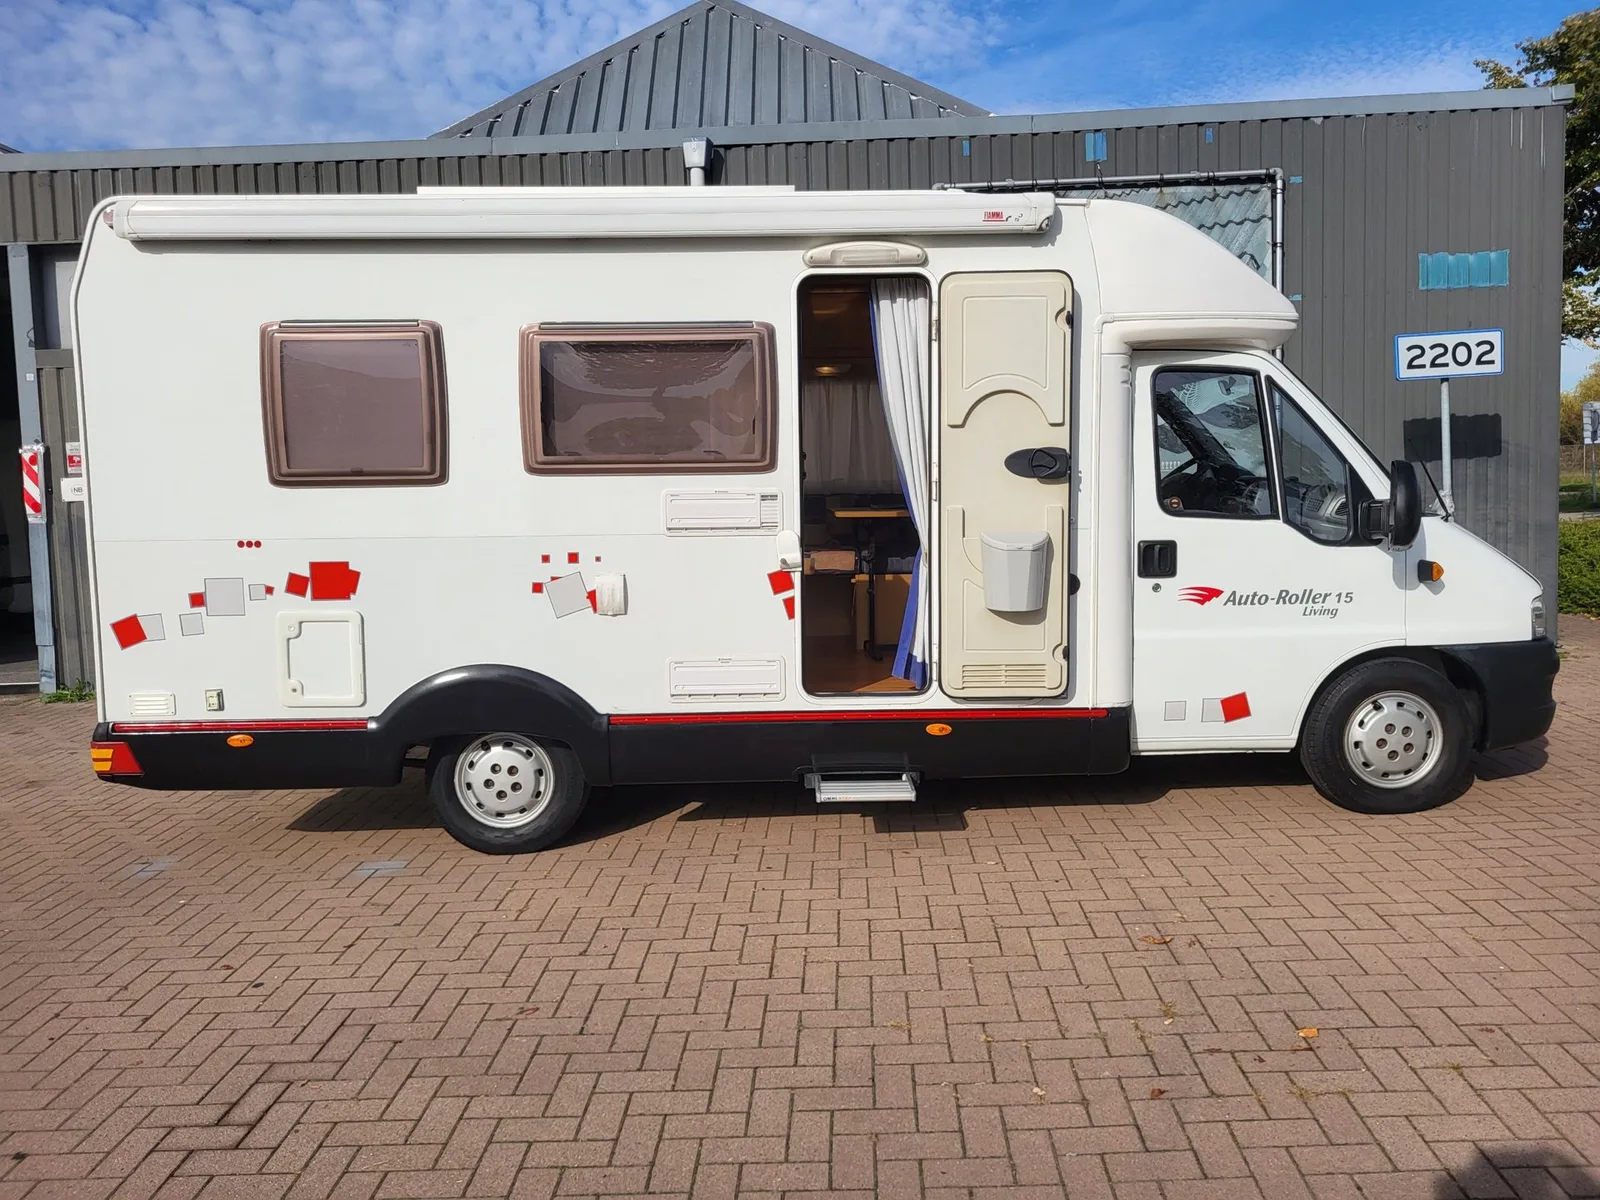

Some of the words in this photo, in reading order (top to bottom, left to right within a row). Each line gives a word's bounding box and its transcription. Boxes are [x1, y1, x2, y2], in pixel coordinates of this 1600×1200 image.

[983, 211, 1004, 220] FIAMMA
[1405, 340, 1495, 370] 2202
[1223, 588, 1332, 606] Auto-Roller
[1335, 592, 1353, 604] 15
[1302, 605, 1339, 619] Living
